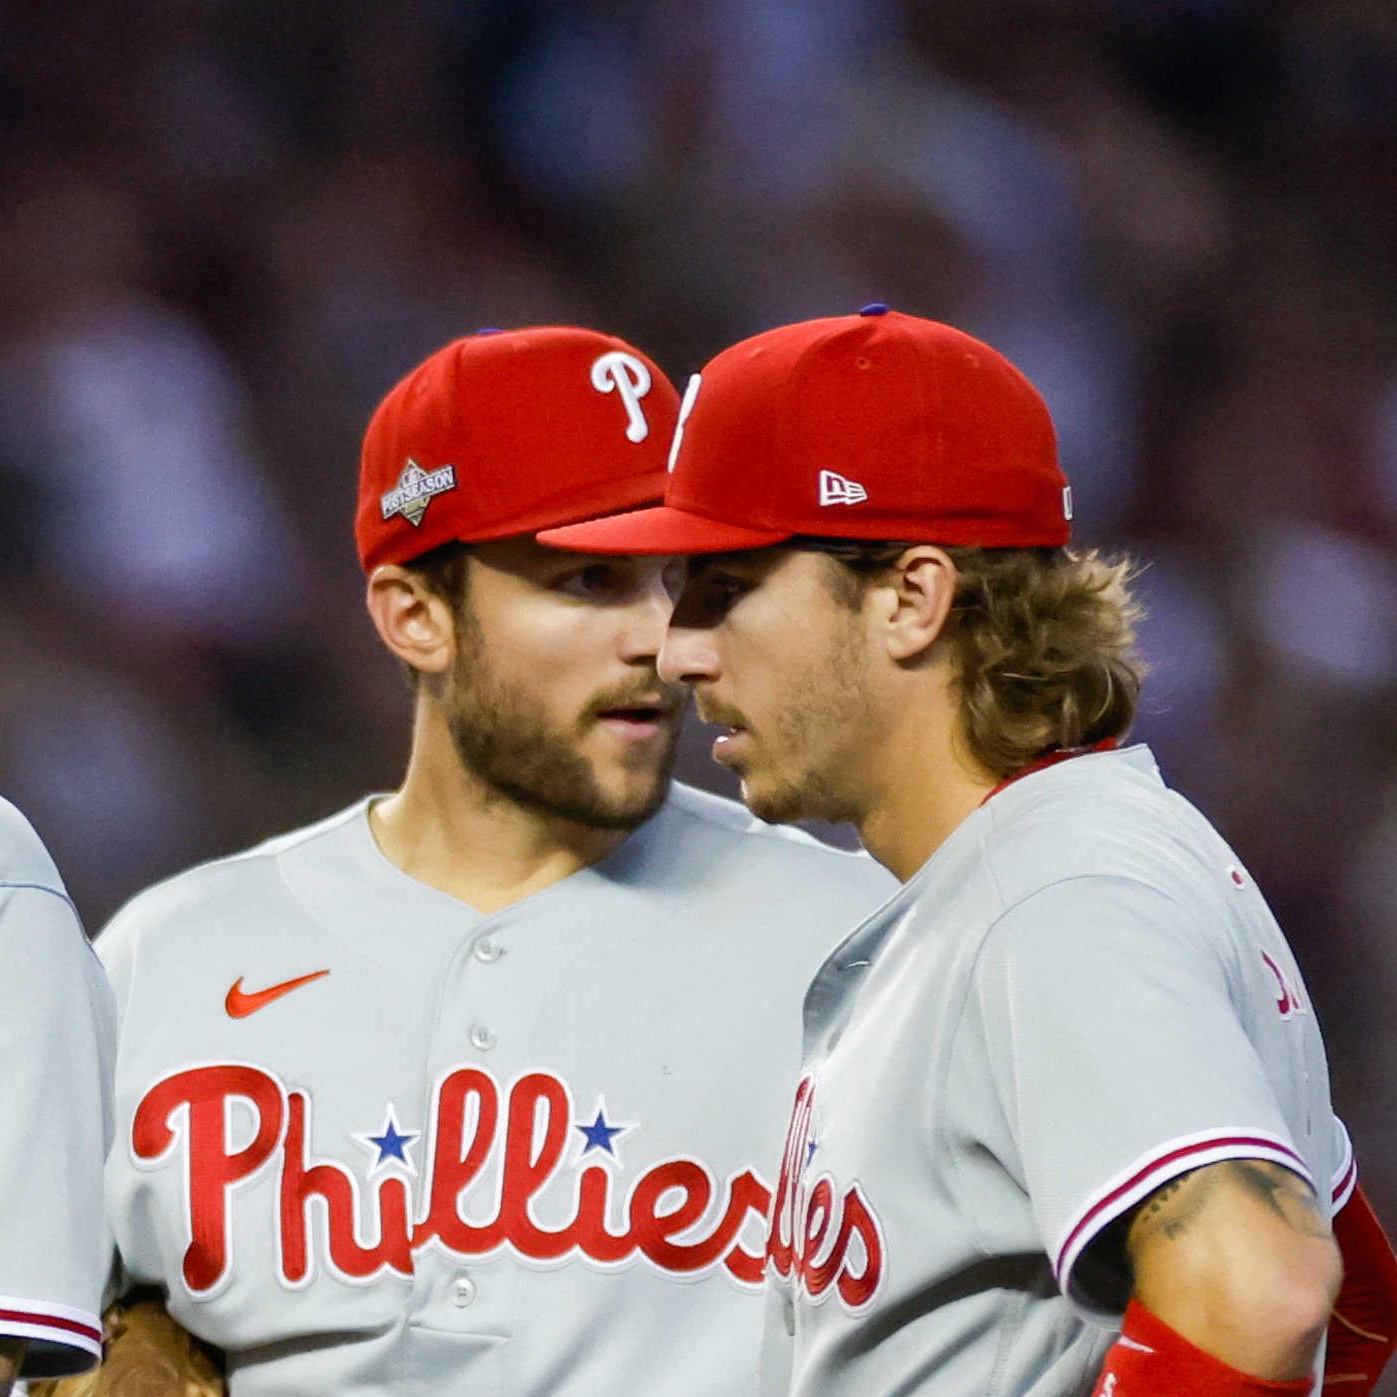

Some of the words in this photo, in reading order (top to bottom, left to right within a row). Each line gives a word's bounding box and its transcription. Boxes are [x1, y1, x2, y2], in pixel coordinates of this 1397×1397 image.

[590, 351, 652, 443] P
[381, 467, 455, 517] POSTSEASON
[130, 1061, 774, 1302] Phillies
